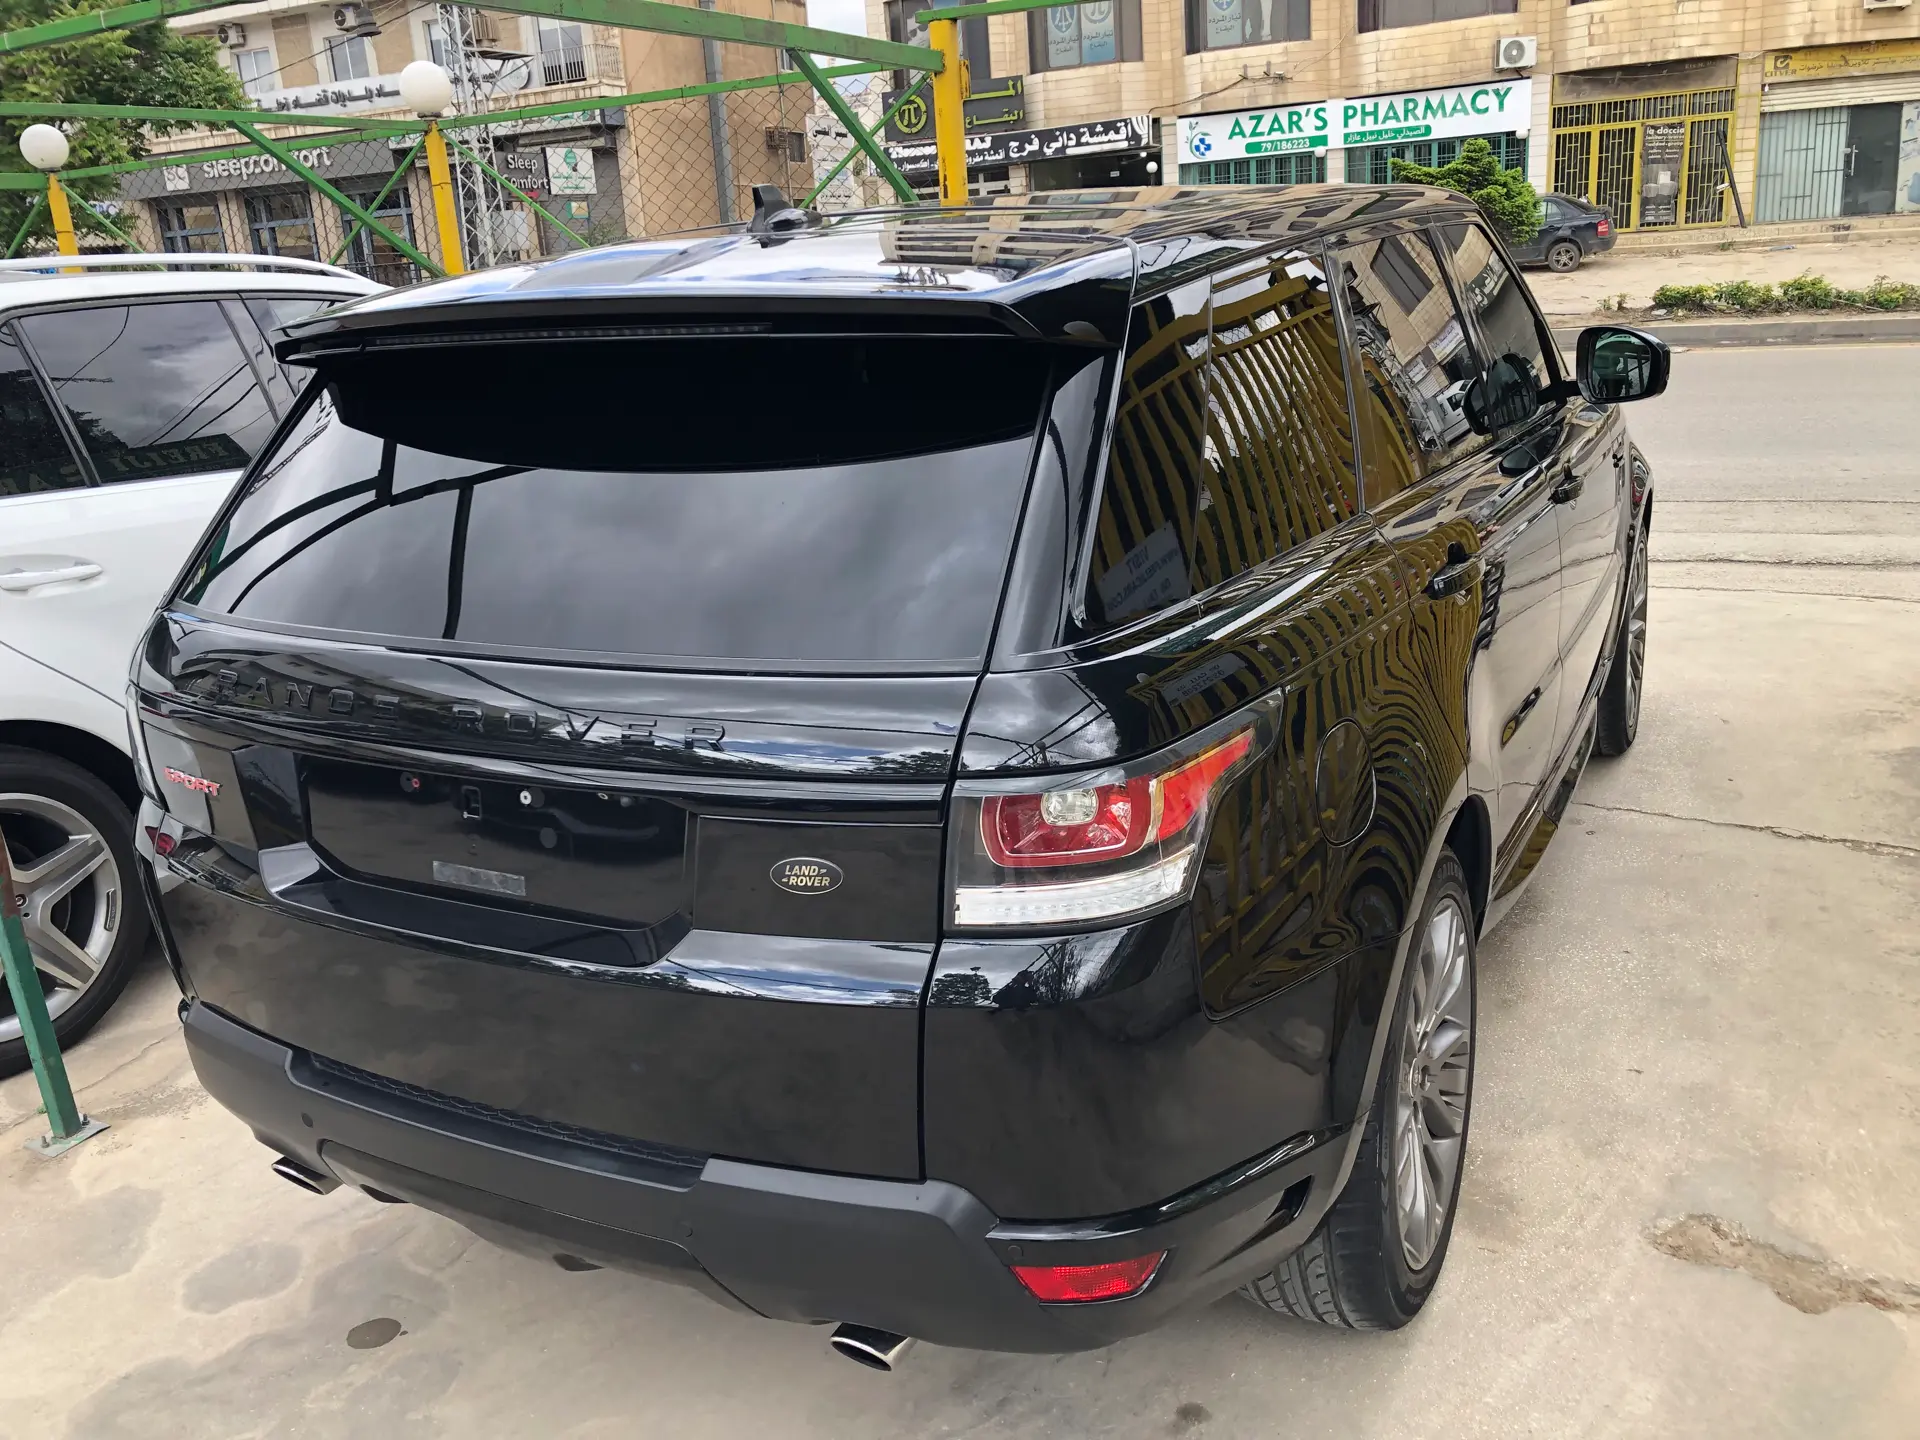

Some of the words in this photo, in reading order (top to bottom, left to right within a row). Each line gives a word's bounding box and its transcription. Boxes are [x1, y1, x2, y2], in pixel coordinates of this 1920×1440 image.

[1227, 106, 1328, 140] AZAR'S
[1343, 86, 1513, 129] PHARMACY
[1043, 130, 1077, 155] داني
[1079, 119, 1132, 144] أقمشة
[1008, 134, 1040, 158] فرج
[1260, 139, 1310, 152] 79/186223
[507, 154, 538, 173] Sleep
[451, 703, 726, 751] ROVER
[164, 766, 223, 797] SPORT
[785, 864, 818, 876] LAND
[788, 876, 831, 887] ROVER
